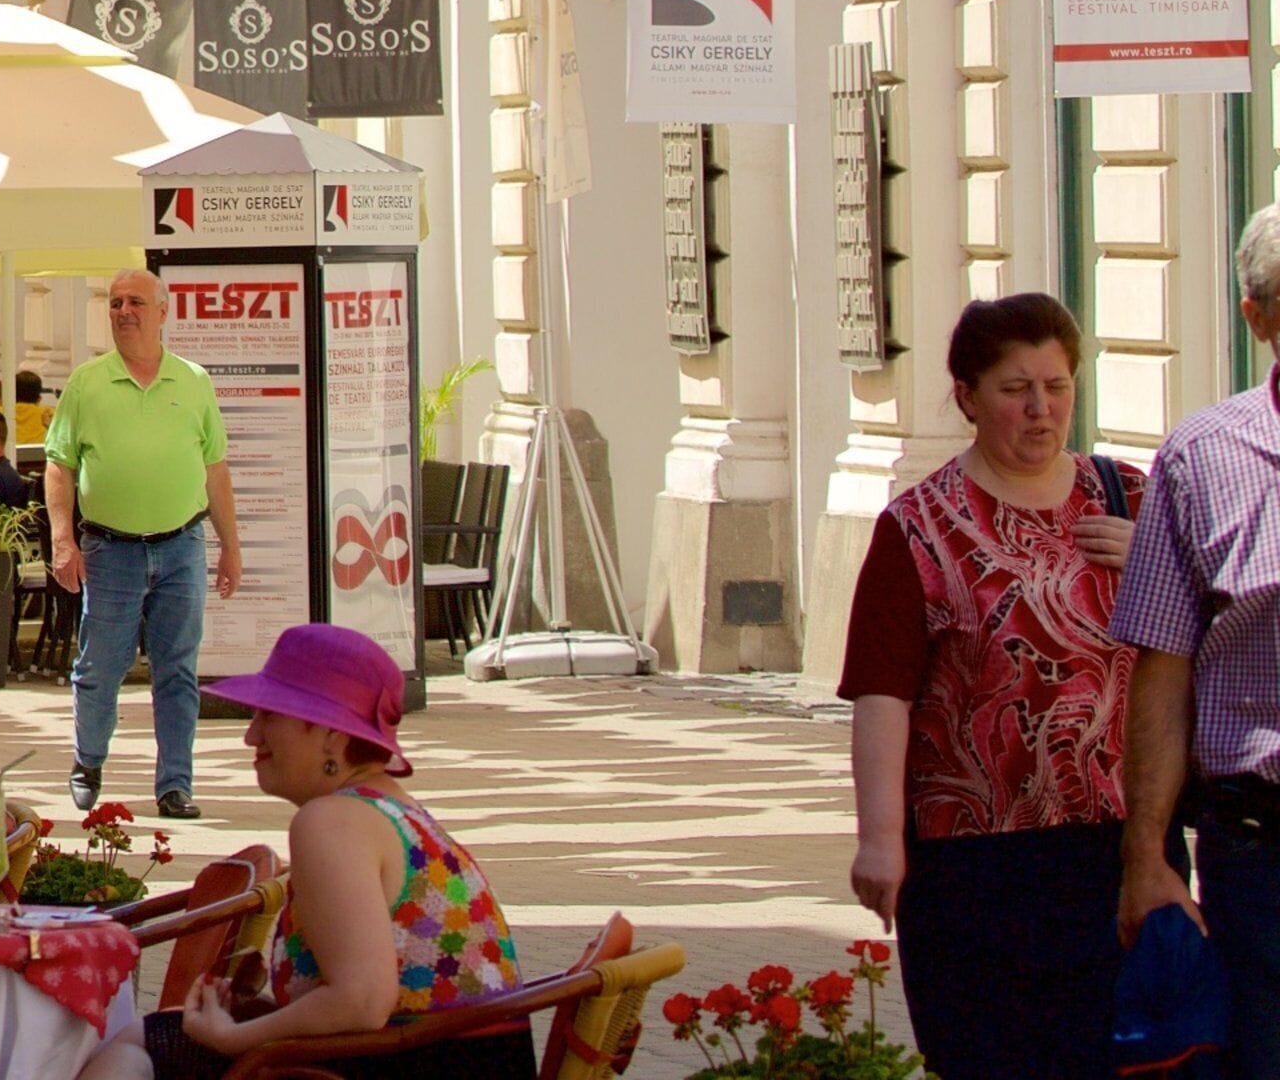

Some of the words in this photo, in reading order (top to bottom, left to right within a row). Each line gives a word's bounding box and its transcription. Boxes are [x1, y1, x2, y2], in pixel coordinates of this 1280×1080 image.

[1068, 3, 1138, 15] FESTIVAL
[651, 34, 688, 42] TEATRUL
[651, 46, 696, 59] CSIKY
[703, 47, 772, 60] GERGELY
[1110, 47, 1192, 57] www.teszt.ro
[691, 64, 728, 72] MAGYAR
[202, 198, 239, 210] CSIKY
[246, 196, 303, 209] GERGELY
[352, 196, 374, 208] CSIKY
[378, 196, 413, 208] GERGELY
[169, 283, 298, 319] TESZT
[325, 290, 402, 329] TESZT
[328, 393, 339, 405] DE
